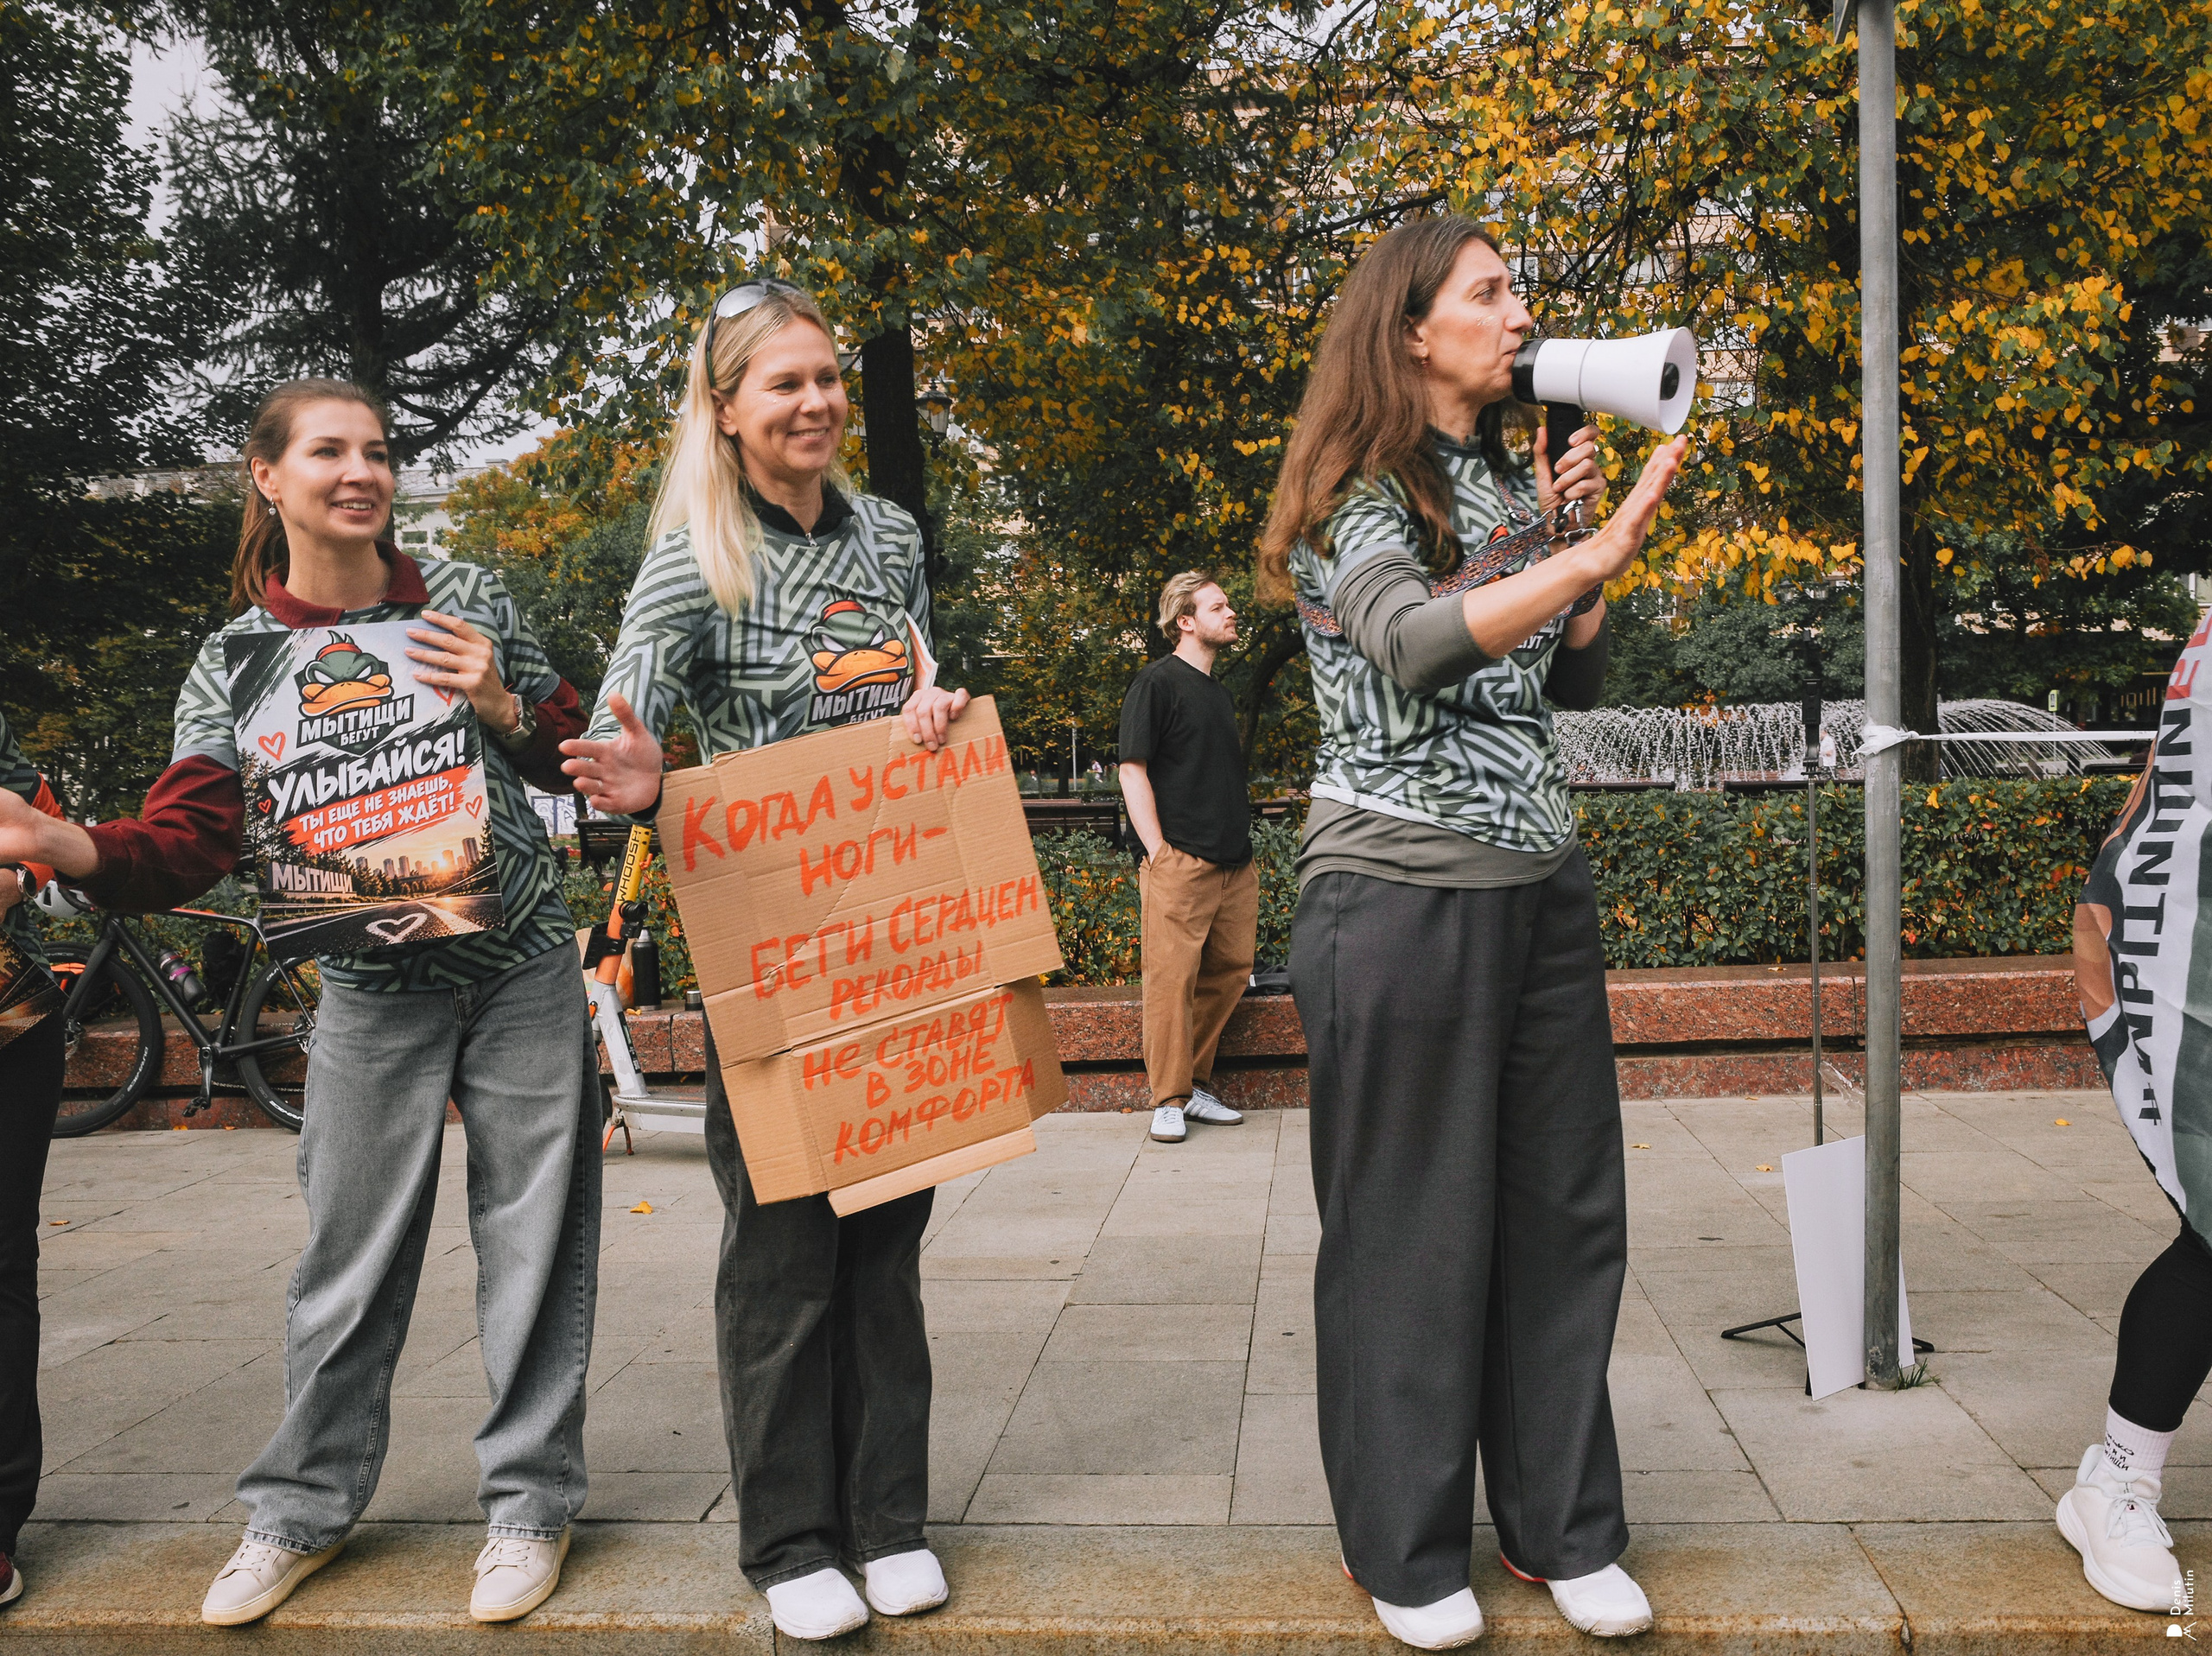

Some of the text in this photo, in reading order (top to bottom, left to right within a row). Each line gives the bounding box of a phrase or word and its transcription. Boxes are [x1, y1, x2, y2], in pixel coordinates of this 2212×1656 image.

[302, 699, 410, 744] МЫТИЩИ
[811, 677, 913, 721] МЫТИЩИ
[340, 727, 379, 746] БЕГУТ
[267, 727, 466, 823] УЛЫБАЙСЯ!
[299, 777, 454, 833] ТЫ ЕЩЕ НЕ ЗНАЕШЬ,
[313, 794, 455, 849] ЧТО ТЕБЯ ЖДЁТ!
[682, 775, 837, 872] КОГДА
[271, 862, 353, 892] МЫТИЩИ
[617, 830, 639, 902] WHOOSH
[750, 914, 874, 1002] БЕГИ
[830, 941, 983, 1021] РЕКОРДЫ
[875, 993, 1014, 1072] СТАВЯТ
[867, 1039, 996, 1110] В ЗОНЕ
[834, 1058, 1035, 1164] КОМФОРТА
